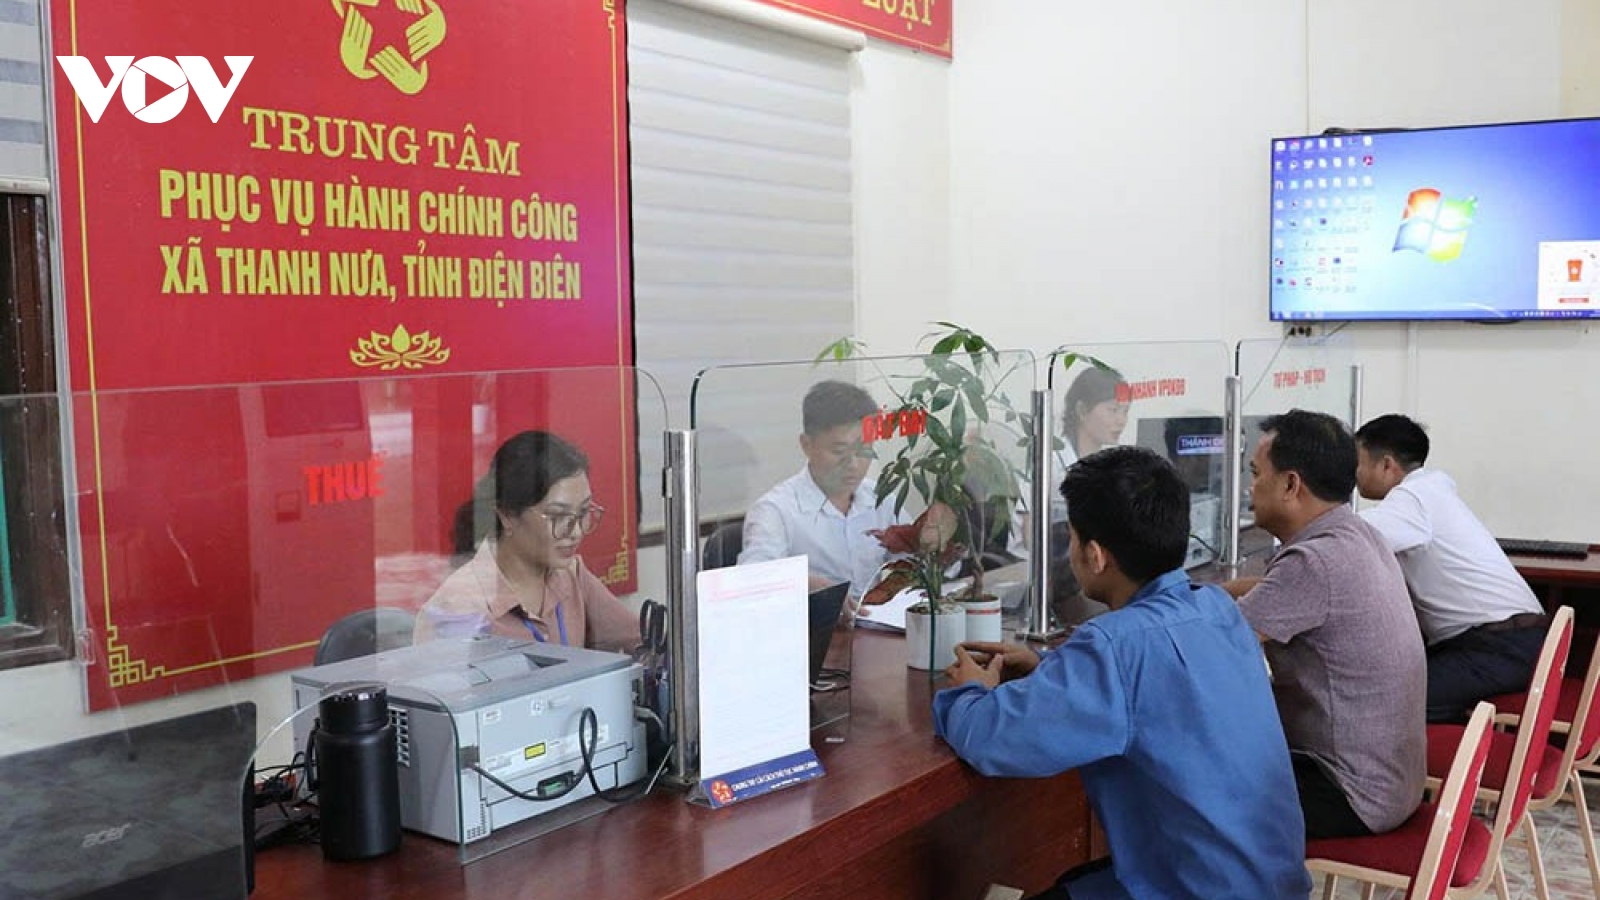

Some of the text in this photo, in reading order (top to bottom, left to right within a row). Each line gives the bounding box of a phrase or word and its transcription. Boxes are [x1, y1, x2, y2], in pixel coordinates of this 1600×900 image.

[863, 0, 935, 31] UẬT
[242, 106, 521, 176] TRUNG TÂM
[159, 169, 578, 242] PHỤC VỤ HÀNH CHÍNH CÔNG
[160, 237, 582, 308] XÃ THANH NƯA, TỈNH ĐIỆN BIÊN
[303, 450, 388, 505] THUẾ
[82, 823, 131, 848] acer
